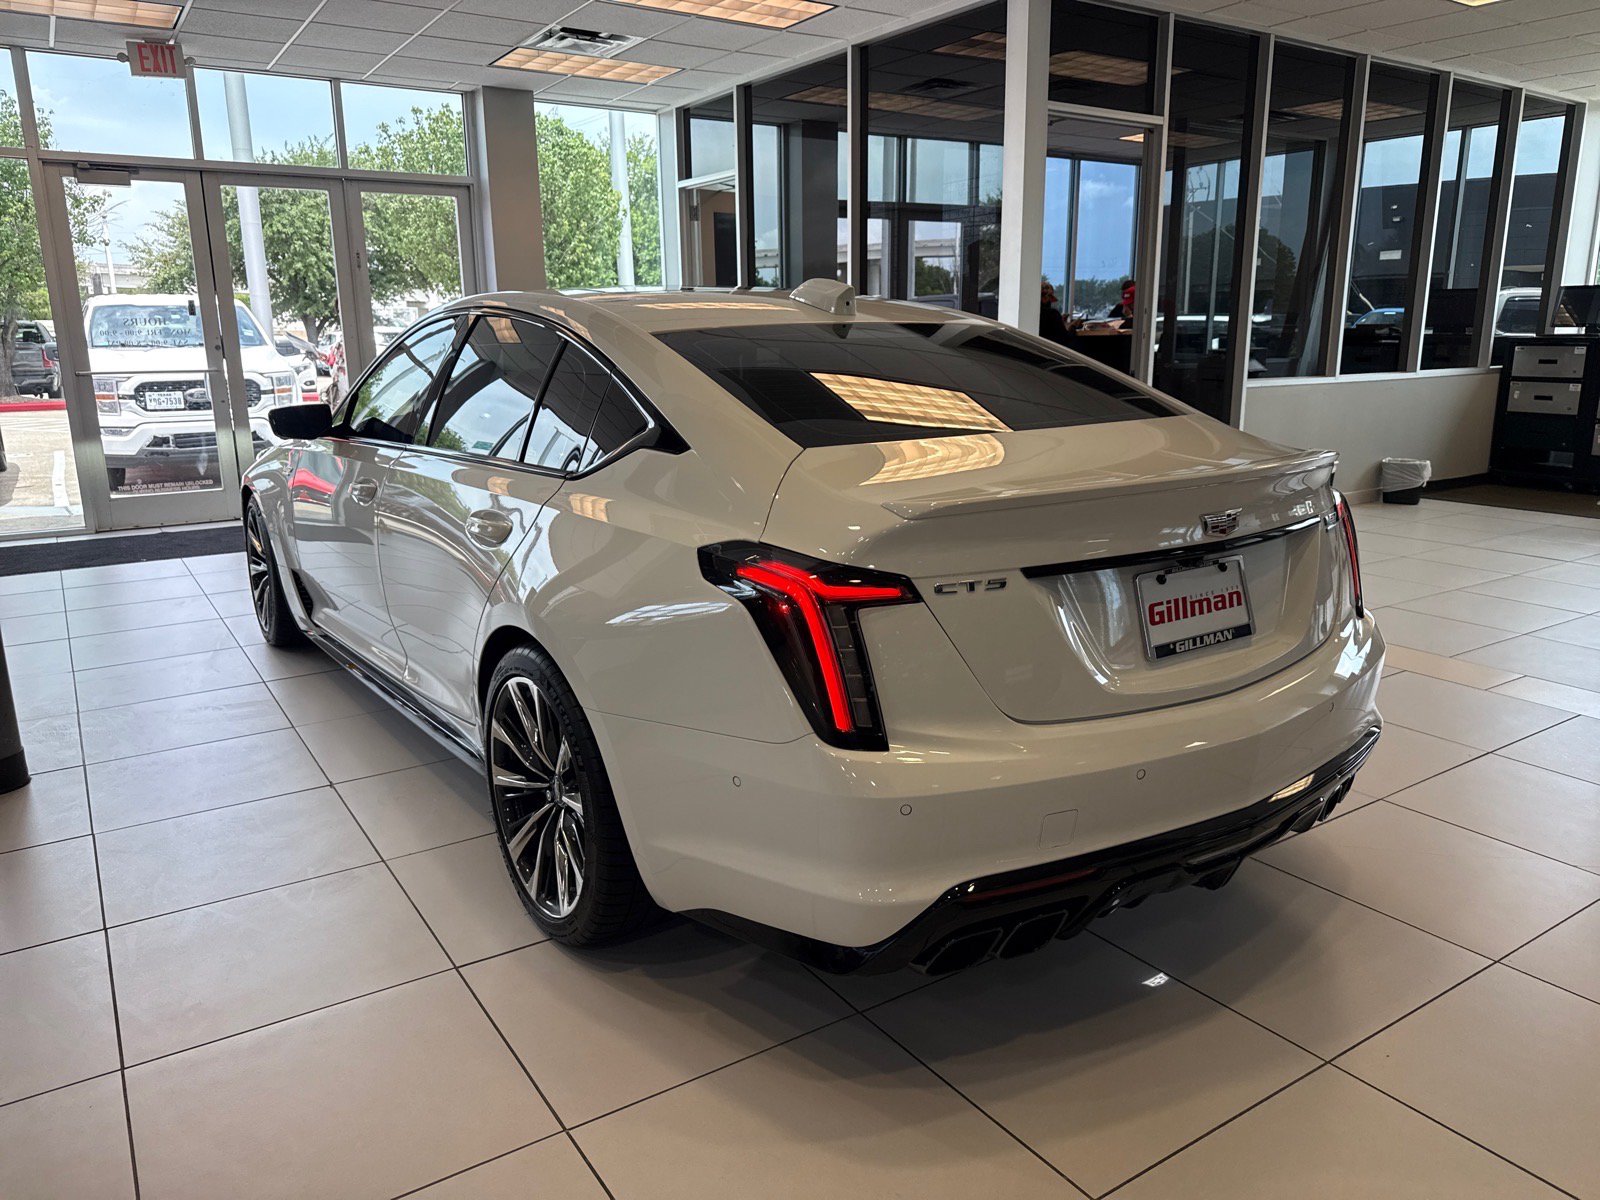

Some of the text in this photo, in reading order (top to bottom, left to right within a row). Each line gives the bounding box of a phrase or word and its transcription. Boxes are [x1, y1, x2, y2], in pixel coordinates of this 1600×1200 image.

[136, 43, 177, 74] EXIT
[185, 479, 214, 487] UNLOCKED
[934, 577, 1007, 594] CT5
[1148, 590, 1243, 627] Gillman
[1175, 628, 1233, 653] GILLMAN
